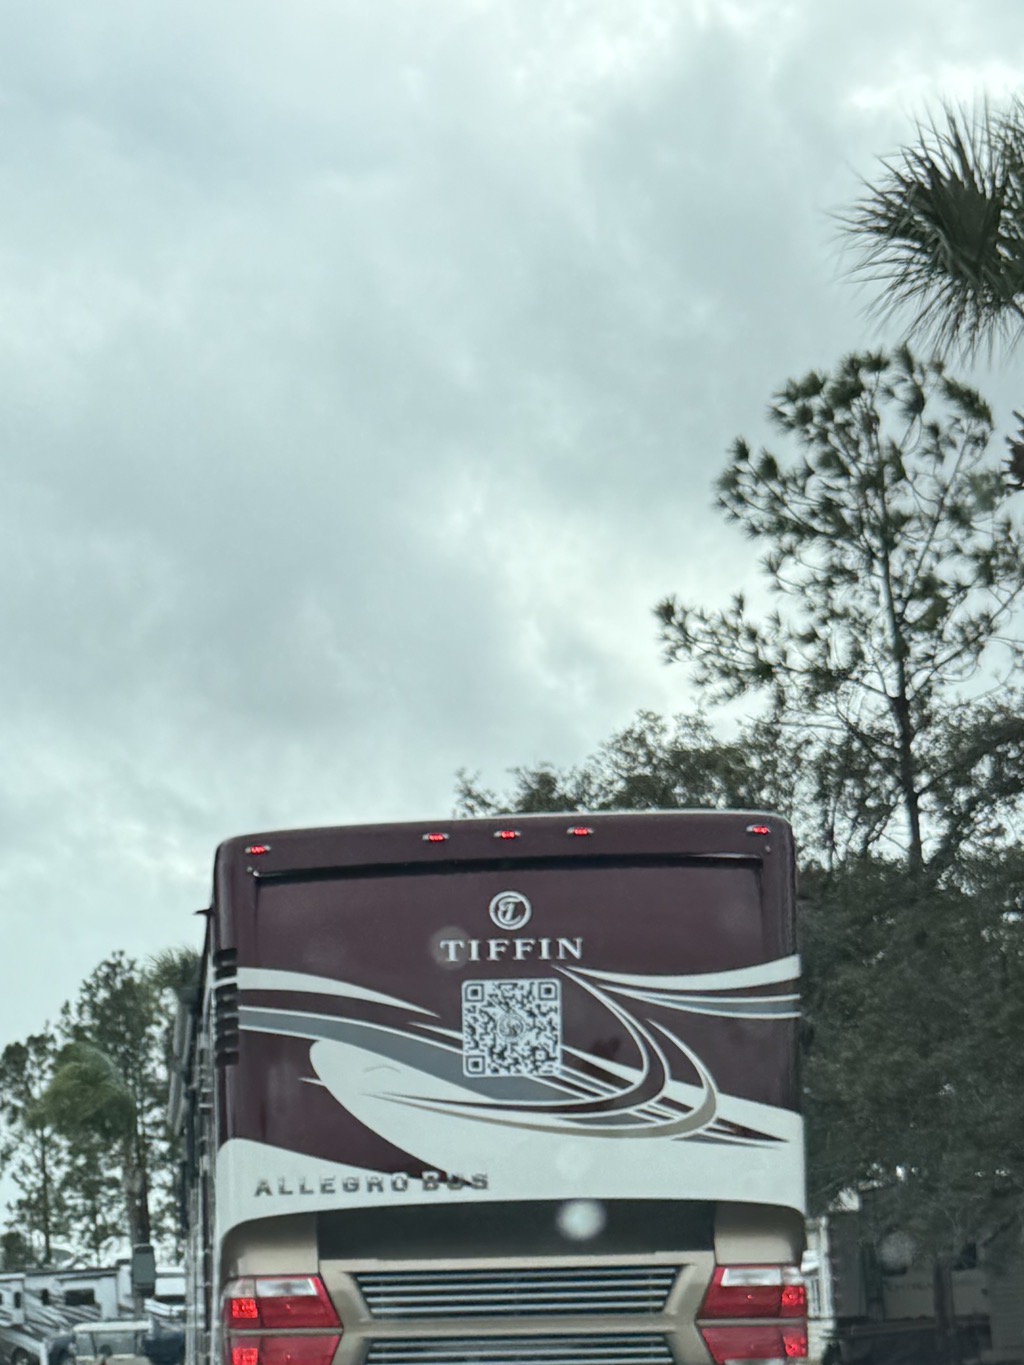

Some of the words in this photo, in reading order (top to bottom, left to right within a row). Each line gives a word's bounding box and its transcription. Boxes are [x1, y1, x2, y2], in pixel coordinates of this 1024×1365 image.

[439, 937, 585, 961] TIFFIN
[254, 1172, 408, 1197] ALLEGRO
[421, 1170, 489, 1192] BUS
